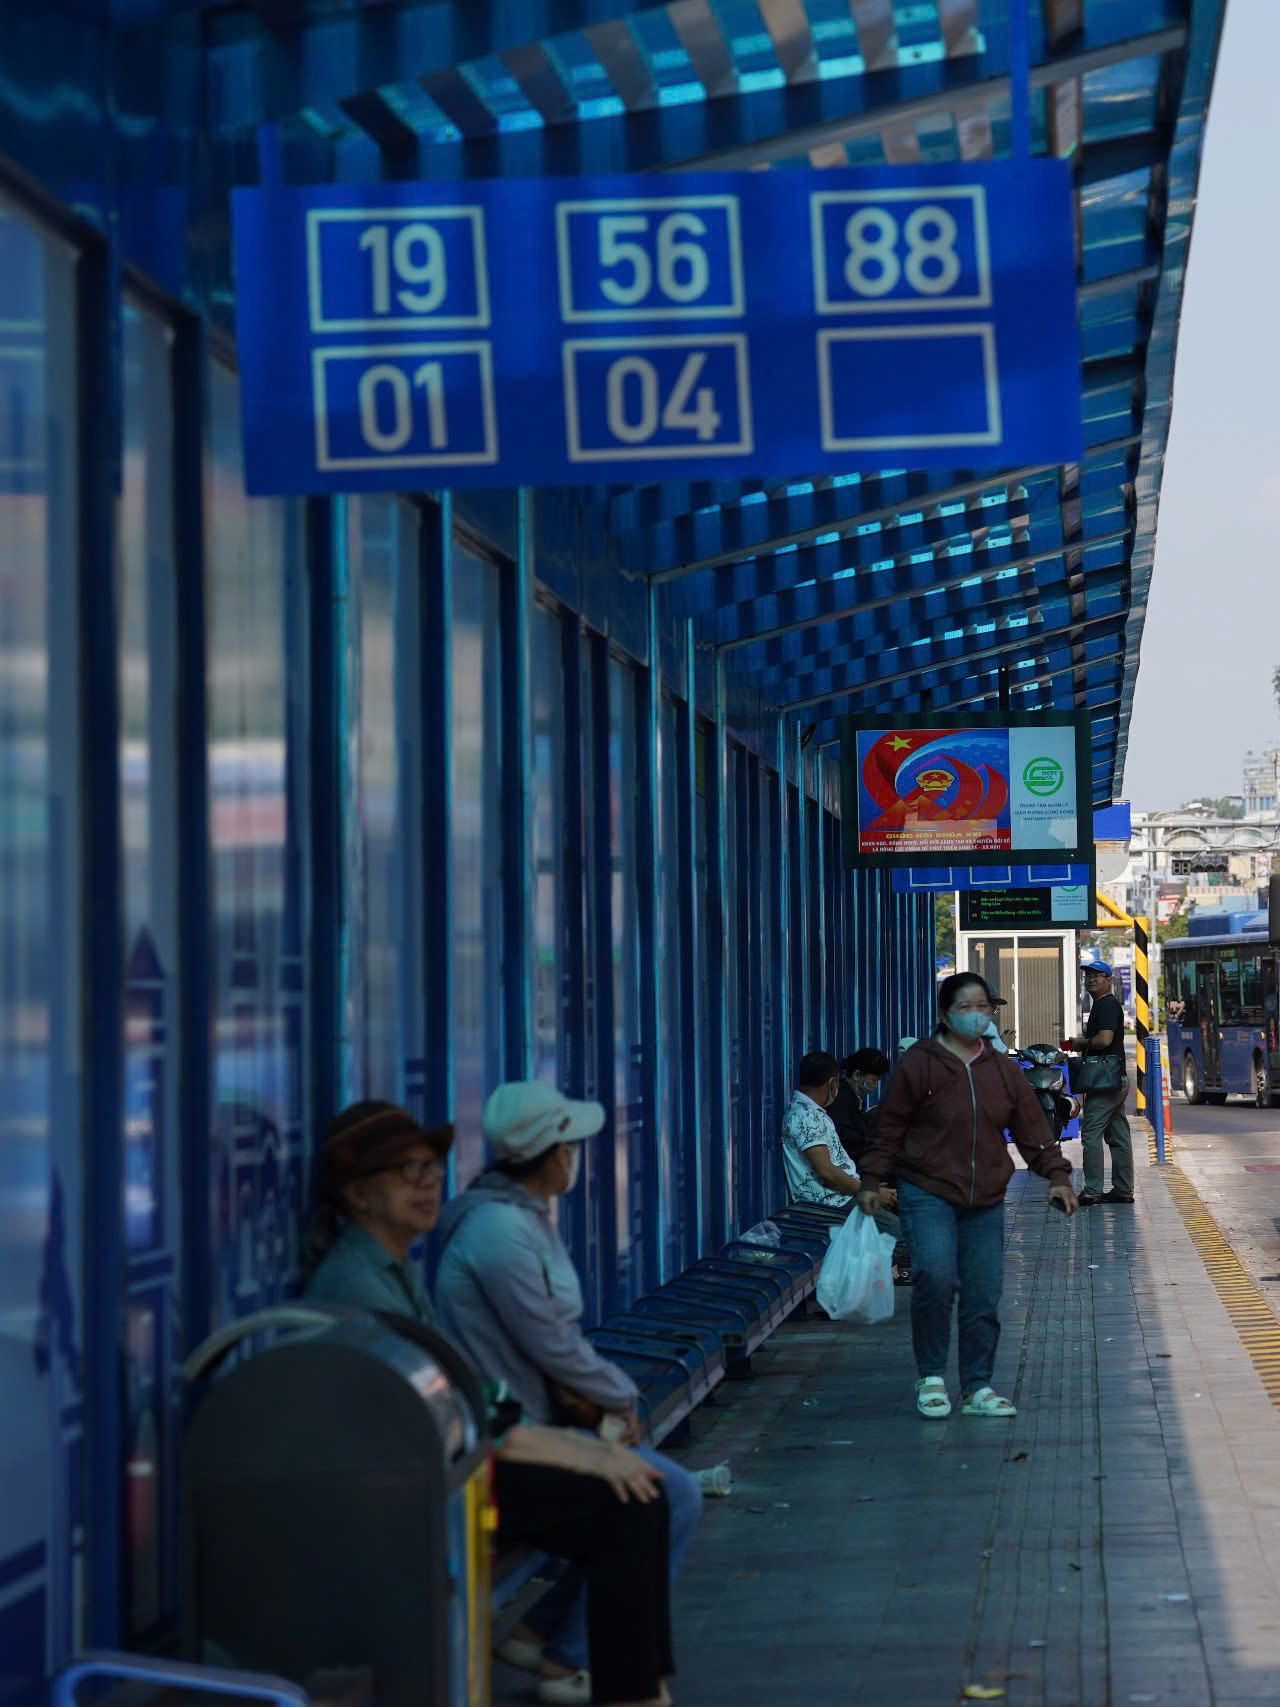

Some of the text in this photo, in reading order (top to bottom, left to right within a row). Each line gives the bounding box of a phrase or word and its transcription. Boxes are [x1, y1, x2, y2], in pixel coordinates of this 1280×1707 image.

[358, 223, 446, 315] 19
[599, 213, 709, 306] 56
[845, 206, 961, 297] 88
[358, 361, 448, 452] 01
[606, 352, 721, 444] 04
